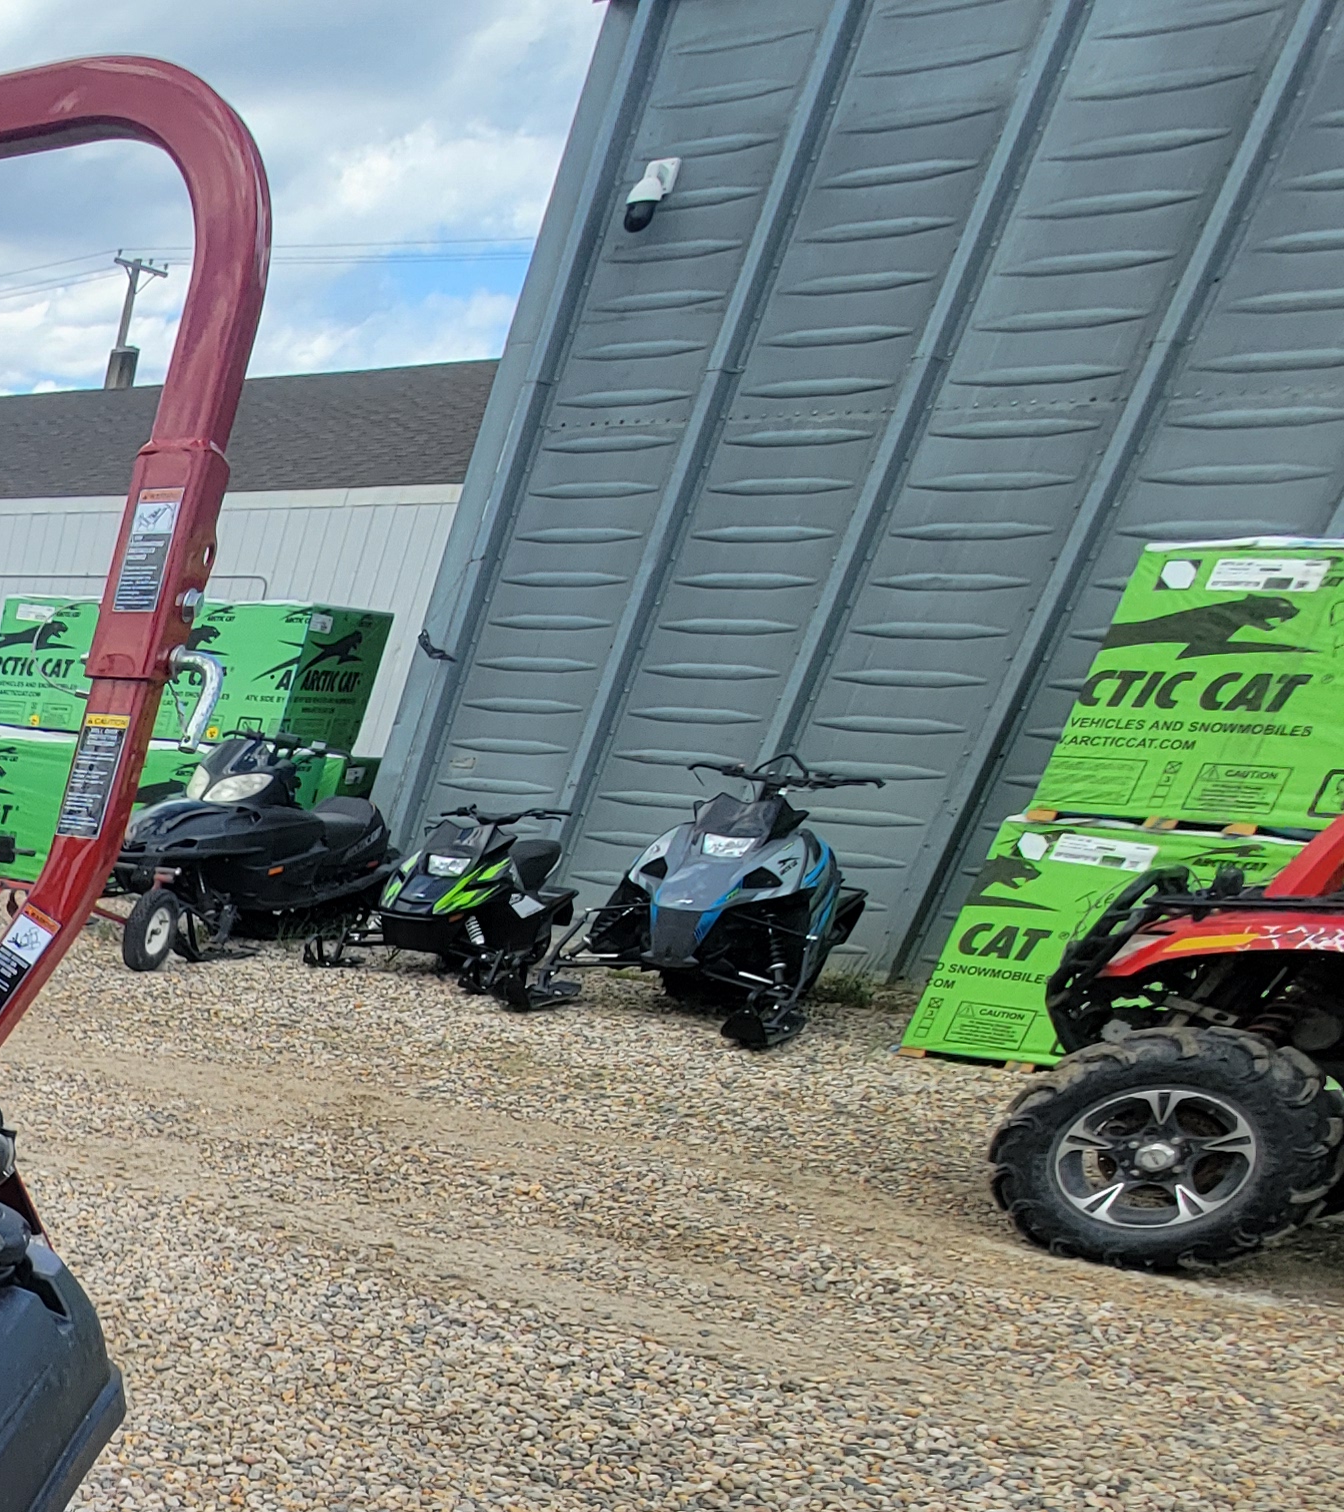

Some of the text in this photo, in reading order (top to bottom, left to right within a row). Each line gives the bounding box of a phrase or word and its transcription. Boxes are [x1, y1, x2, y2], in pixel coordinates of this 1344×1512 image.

[41, 658, 76, 678] CAT
[1199, 671, 1314, 713] CAT
[1070, 717, 1314, 737] VEHICLES AND SNOWMOBILES
[1225, 769, 1279, 780] CAUTION
[958, 923, 1053, 961] CAT
[979, 1008, 1025, 1021] CAUTION
